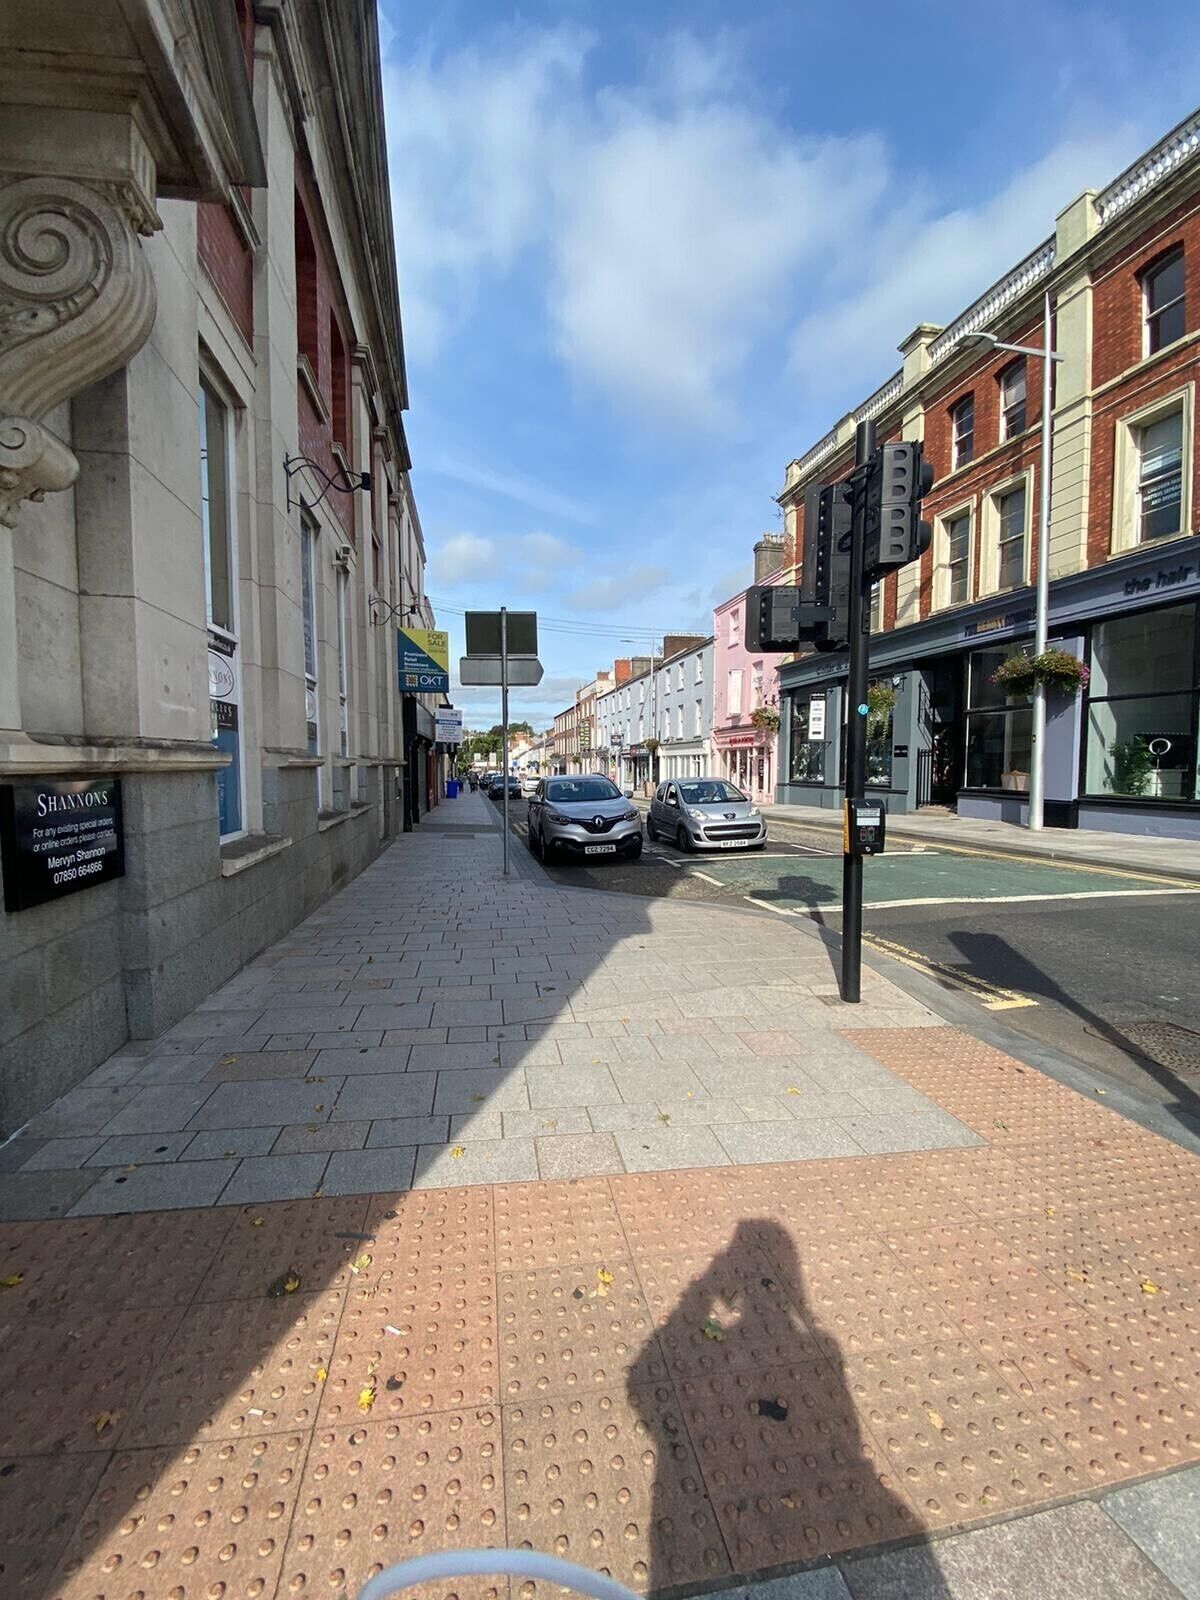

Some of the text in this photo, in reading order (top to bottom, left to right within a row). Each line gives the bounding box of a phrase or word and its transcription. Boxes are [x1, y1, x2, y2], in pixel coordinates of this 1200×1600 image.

[1155, 563, 1193, 588] hair
[427, 632, 443, 641] FOR
[427, 639, 445, 647] SALE
[419, 675, 444, 686] OKT
[33, 817, 113, 838] For any existing special orders
[33, 828, 114, 853] or online orders please contact
[47, 846, 106, 869] Mervyn Shannon
[53, 868, 78, 885] 07850
